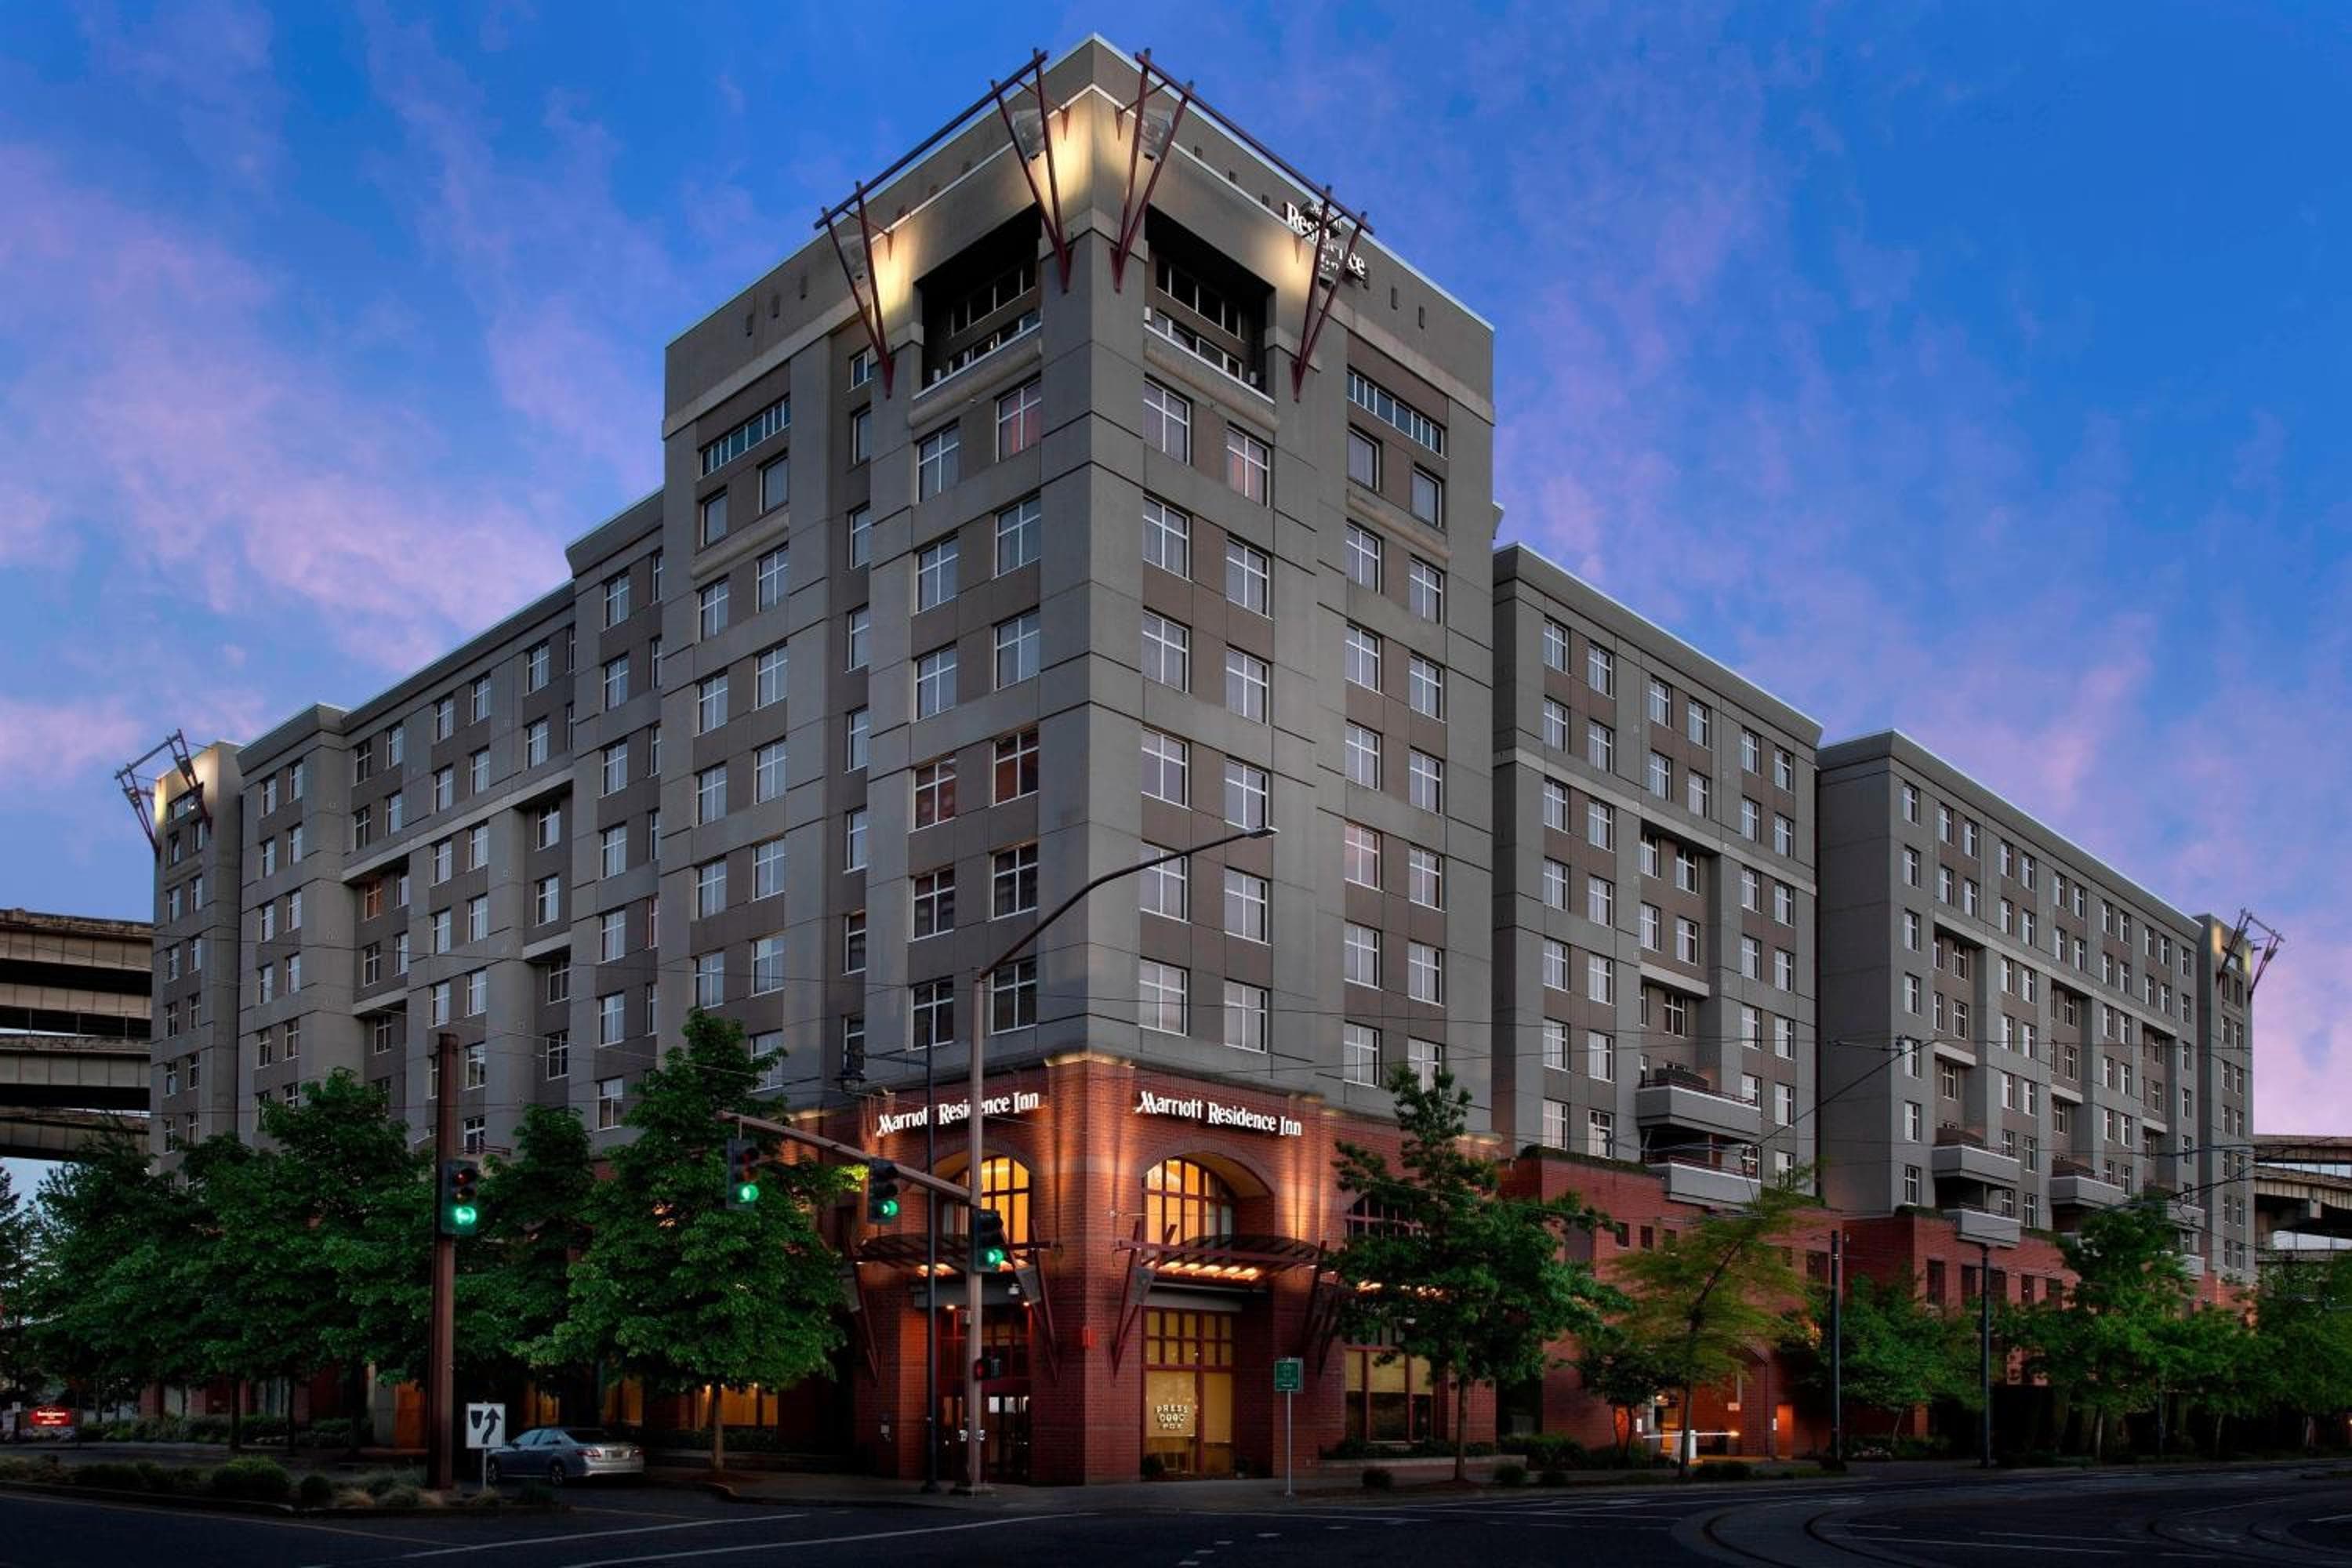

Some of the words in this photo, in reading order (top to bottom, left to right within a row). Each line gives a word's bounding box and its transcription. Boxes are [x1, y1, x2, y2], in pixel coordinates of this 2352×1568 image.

[1287, 201, 1365, 275] Resice
[876, 1106, 930, 1137] Marriot
[938, 1097, 1011, 1125] Resince
[1013, 1091, 1039, 1114] Inn
[1134, 1091, 1203, 1119] Marriott
[1207, 1102, 1277, 1131] Residence
[1279, 1116, 1301, 1136] Inn
